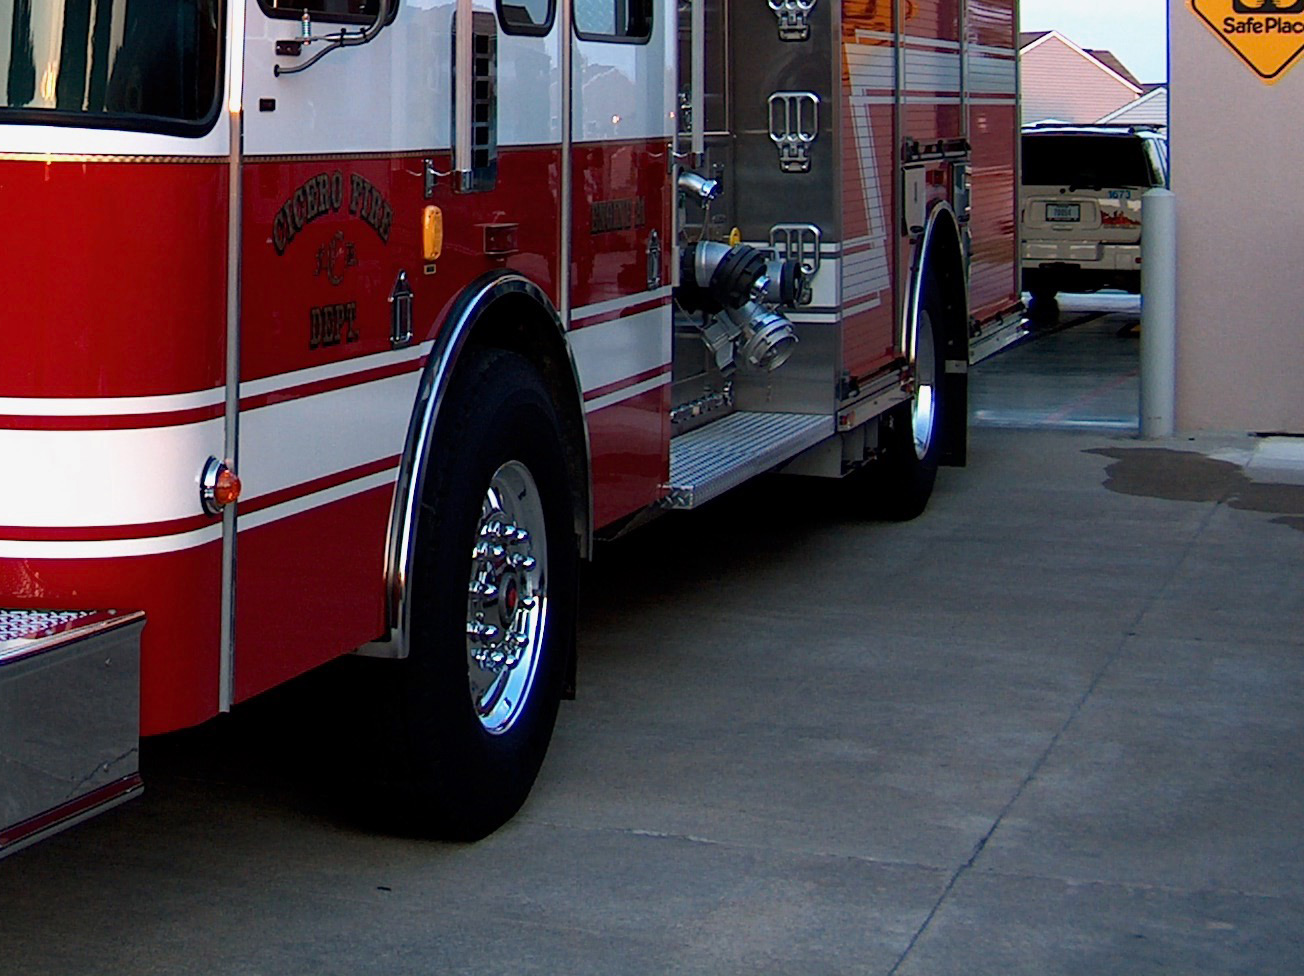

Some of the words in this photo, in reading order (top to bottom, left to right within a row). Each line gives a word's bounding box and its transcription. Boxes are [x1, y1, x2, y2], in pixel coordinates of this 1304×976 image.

[1223, 17, 1263, 34] Safe
[273, 170, 344, 256] CICERO
[349, 172, 393, 245] FIRE
